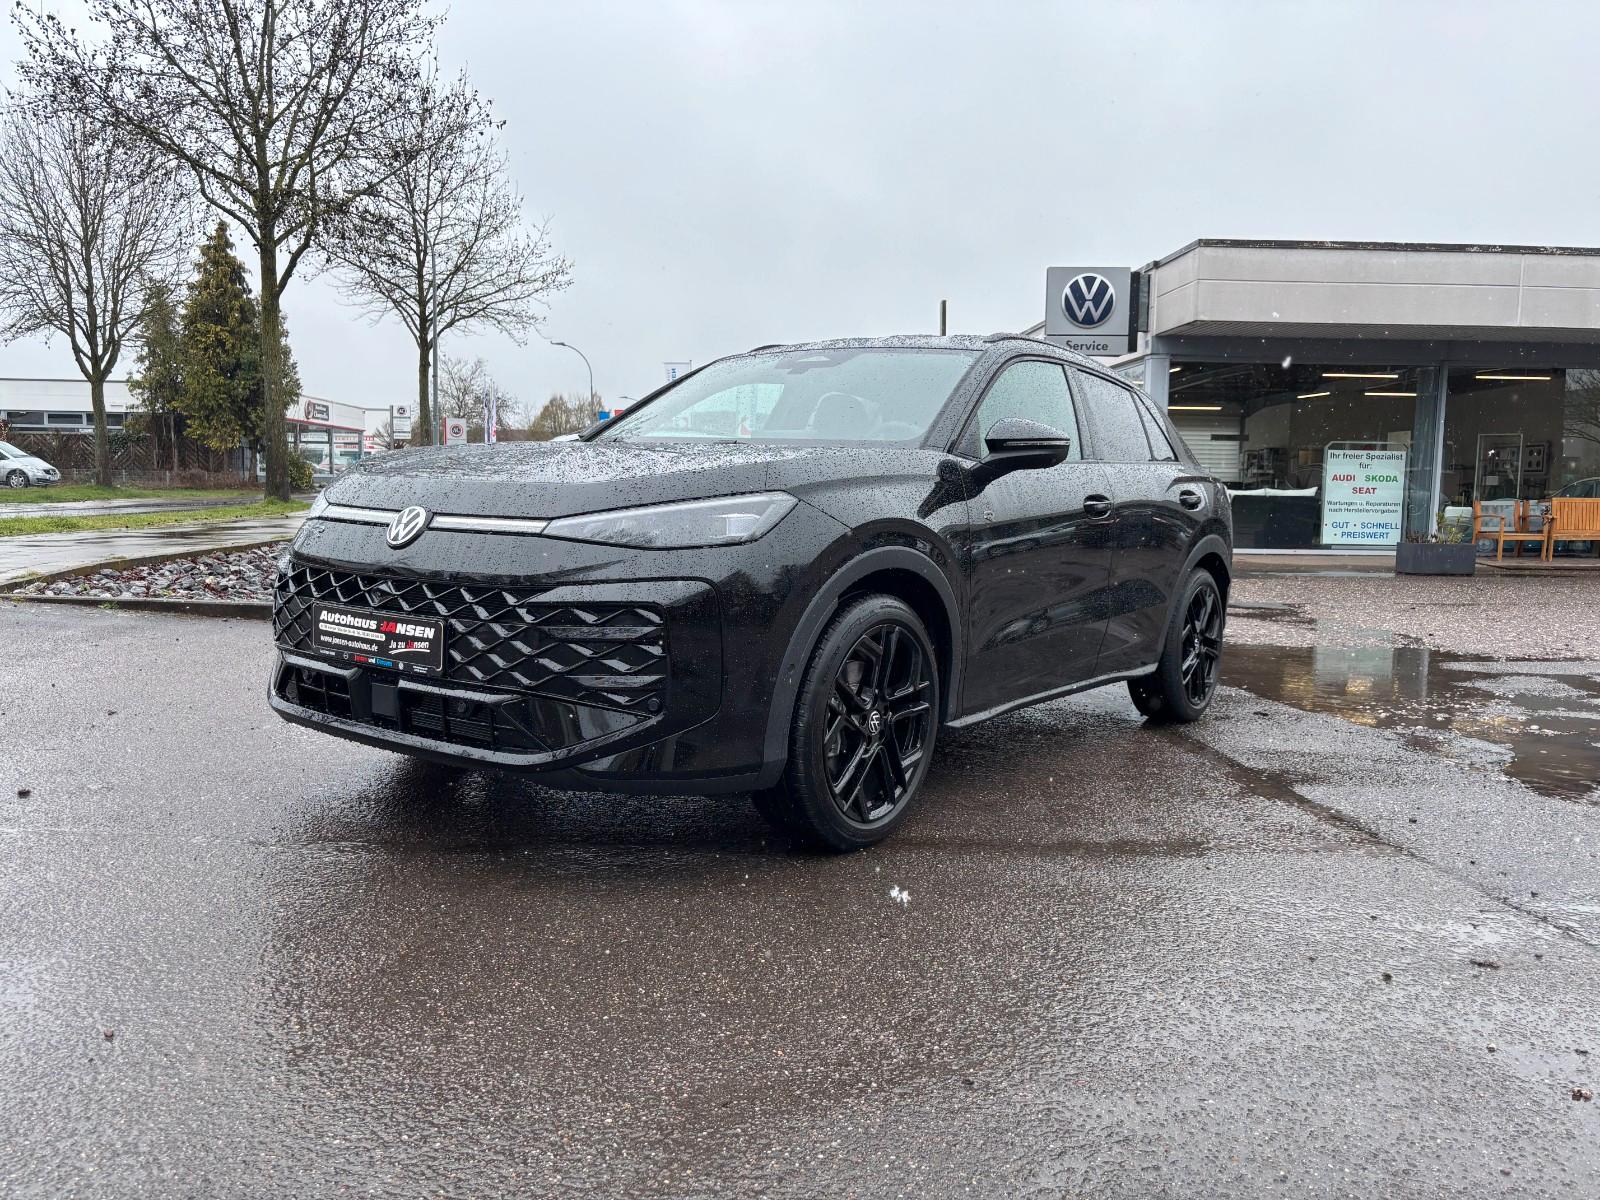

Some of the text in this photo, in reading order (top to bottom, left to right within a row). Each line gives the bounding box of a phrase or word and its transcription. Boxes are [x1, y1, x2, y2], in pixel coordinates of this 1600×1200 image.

[1065, 340, 1109, 351] Service
[1366, 453, 1403, 461] Spezialist
[320, 610, 378, 630] Autohaus
[380, 621, 435, 639] JANSEN
[320, 634, 379, 652] www.jansen-autohaus.de
[388, 639, 430, 650] Ja zu Jansen
